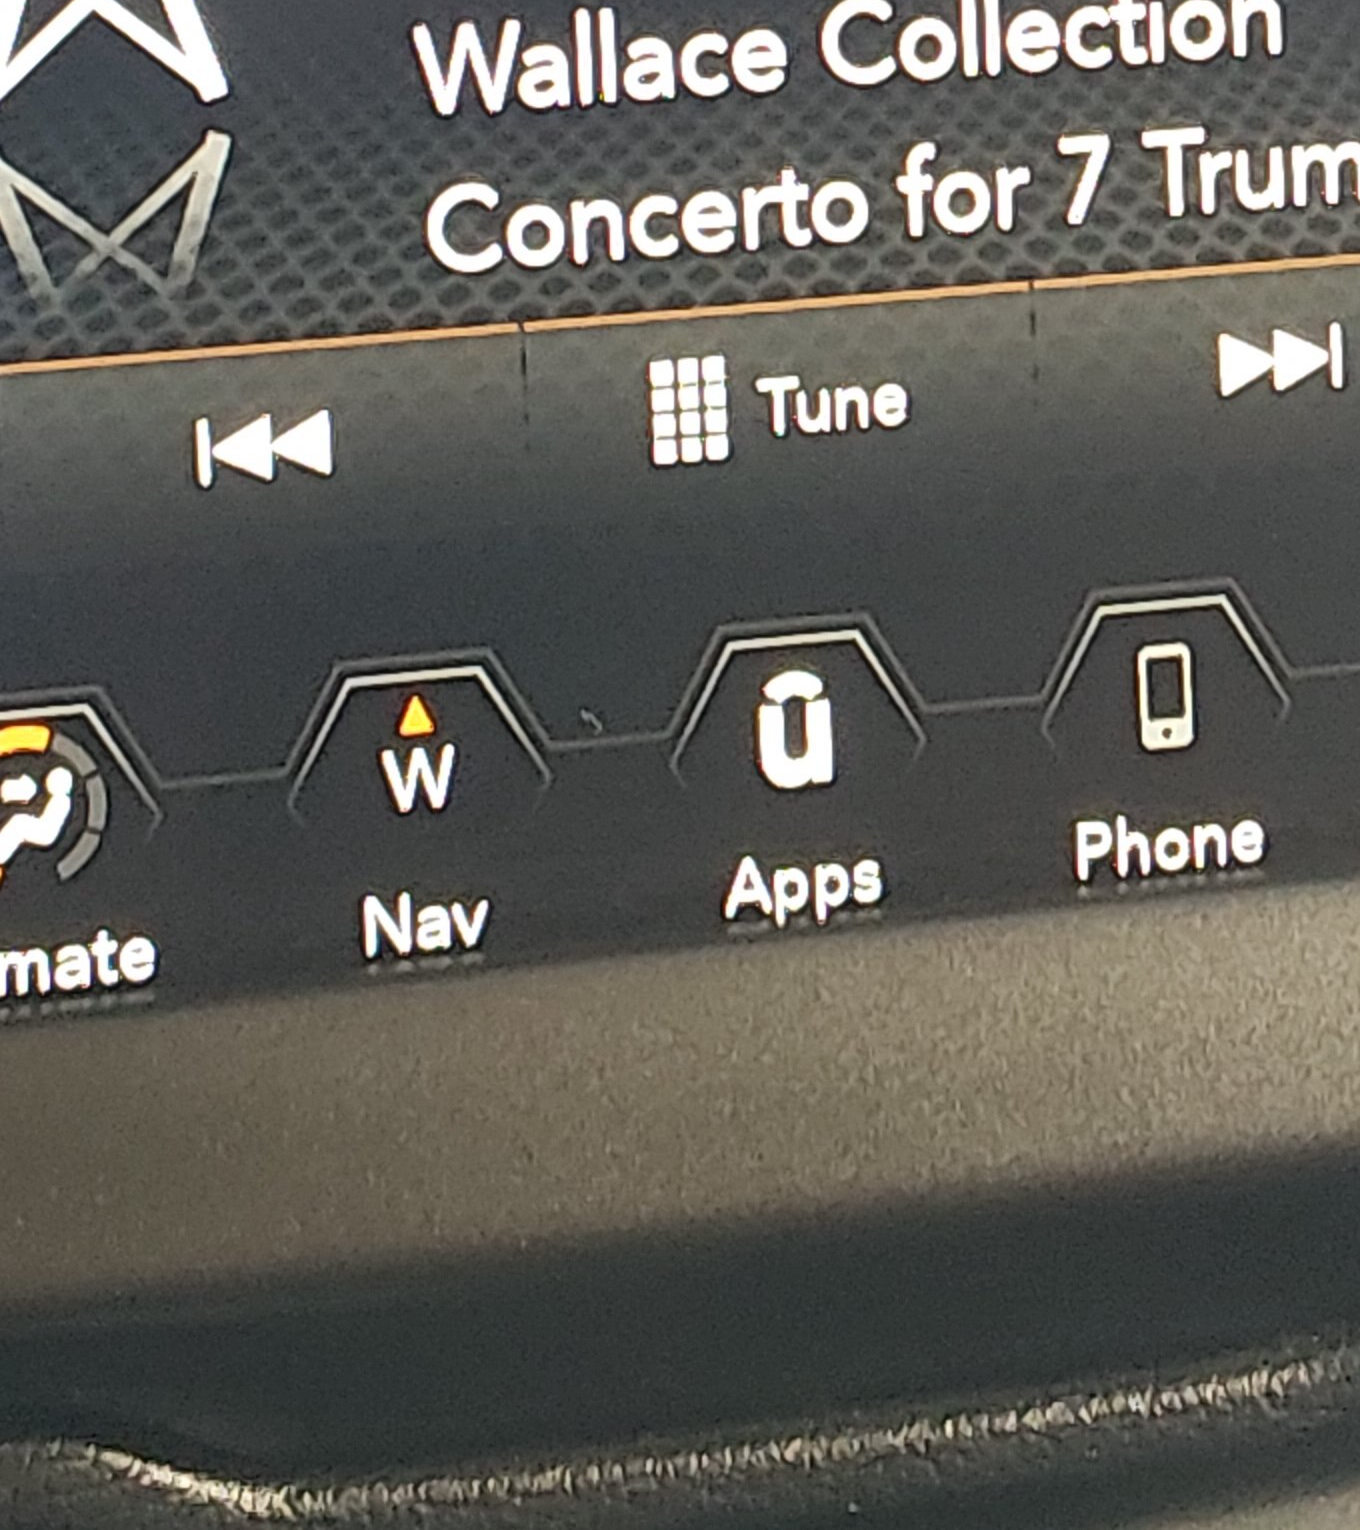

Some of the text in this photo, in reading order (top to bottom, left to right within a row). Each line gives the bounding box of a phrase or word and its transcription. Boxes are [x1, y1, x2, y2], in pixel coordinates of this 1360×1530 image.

[412, 7, 788, 116] Wallace
[426, 166, 869, 273] Concerto
[895, 141, 1031, 237] for
[1057, 131, 1110, 225] 7
[755, 375, 907, 435] Tune
[381, 743, 455, 813] W
[1076, 814, 1265, 881] Phone
[363, 891, 489, 958] Nav
[724, 855, 883, 927] Apps
